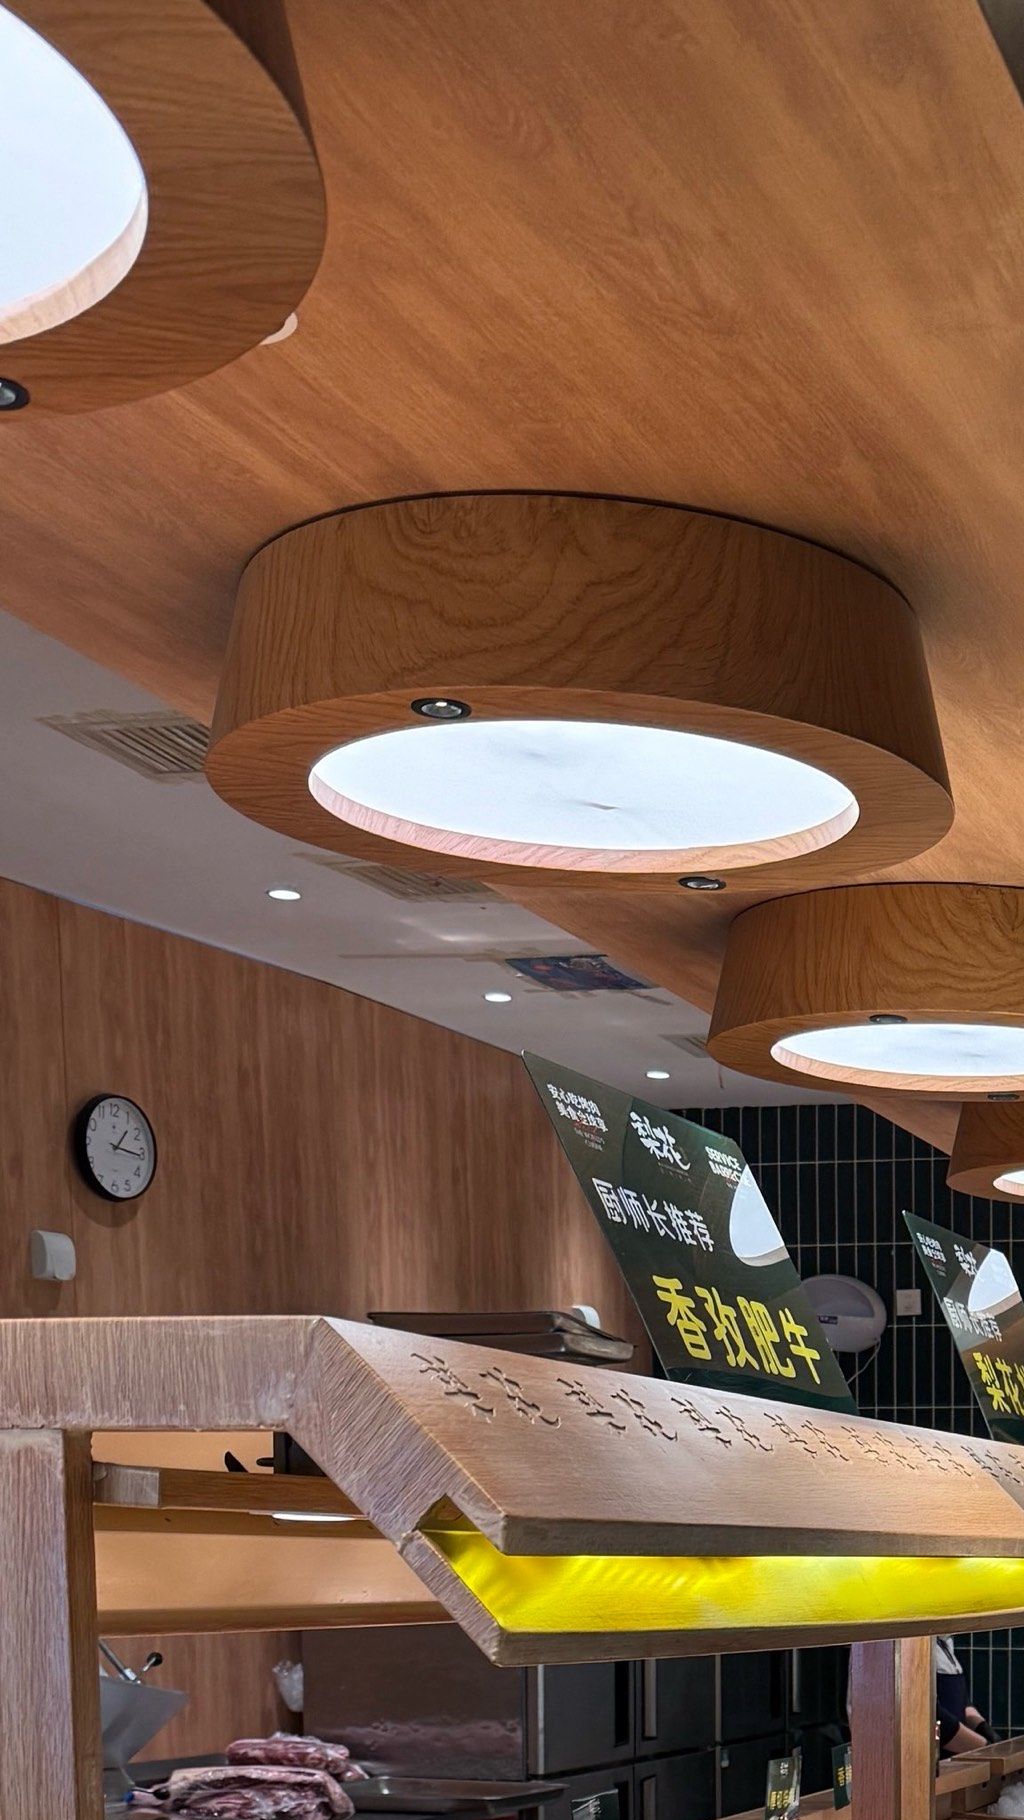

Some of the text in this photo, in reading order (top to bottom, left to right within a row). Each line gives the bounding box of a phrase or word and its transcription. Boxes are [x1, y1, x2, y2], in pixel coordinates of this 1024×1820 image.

[592, 1177, 714, 1252] 厨师长推荐
[652, 1275, 821, 1384] 香孜肥牛
